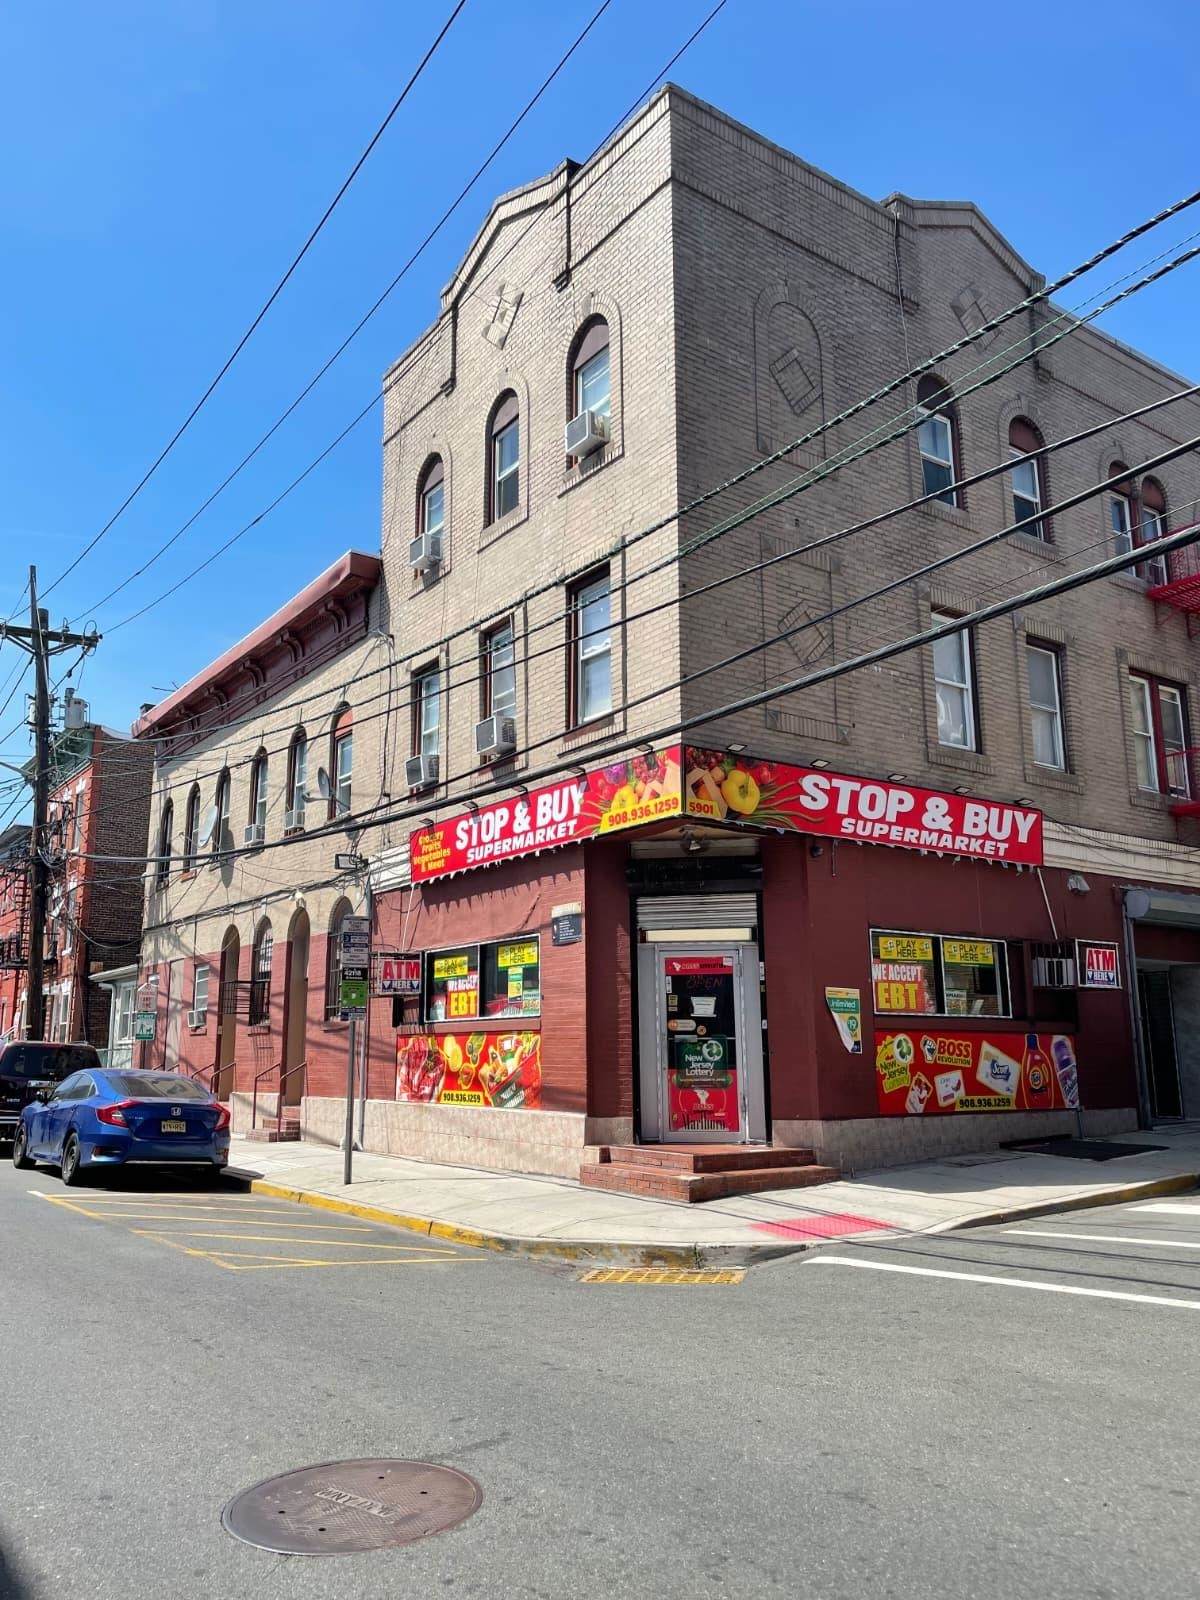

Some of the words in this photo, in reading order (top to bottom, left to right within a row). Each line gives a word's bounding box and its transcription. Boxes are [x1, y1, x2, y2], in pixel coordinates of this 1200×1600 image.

[608, 797, 680, 826] 908.936.1259
[688, 801, 715, 815] 5901
[800, 774, 915, 823] STOP
[921, 797, 954, 832] &
[962, 802, 1038, 843] BUY
[455, 807, 510, 850] STOP
[513, 805, 531, 833] &
[536, 781, 588, 824] BUY
[466, 819, 578, 864] SUPERMARKET
[840, 817, 1009, 857] SUPERMARKET
[510, 945, 526, 954] PLAY
[895, 939, 917, 949] PLAY
[958, 944, 978, 953] PLAY
[510, 953, 526, 964] HERE
[896, 948, 918, 958] HERE
[959, 953, 979, 962] HERE
[1087, 949, 1115, 971] ATM
[382, 960, 420, 979] ATM
[871, 964, 888, 980] WE
[889, 964, 923, 981] ACCEPT
[1093, 971, 1109, 981] HERE
[392, 979, 411, 989] HERE
[877, 982, 919, 1010] EBT
[450, 990, 477, 1016] EBT
[937, 1039, 971, 1059] BOSS
[685, 1054, 703, 1062] New
[937, 1056, 971, 1066] REVOLUTION
[690, 1061, 714, 1070] Jersey
[888, 1064, 907, 1079] Jersey
[686, 1067, 714, 1077] Lottery
[443, 1093, 481, 1103] 908.936.1259
[959, 1097, 1011, 1109] 908.936.1259
